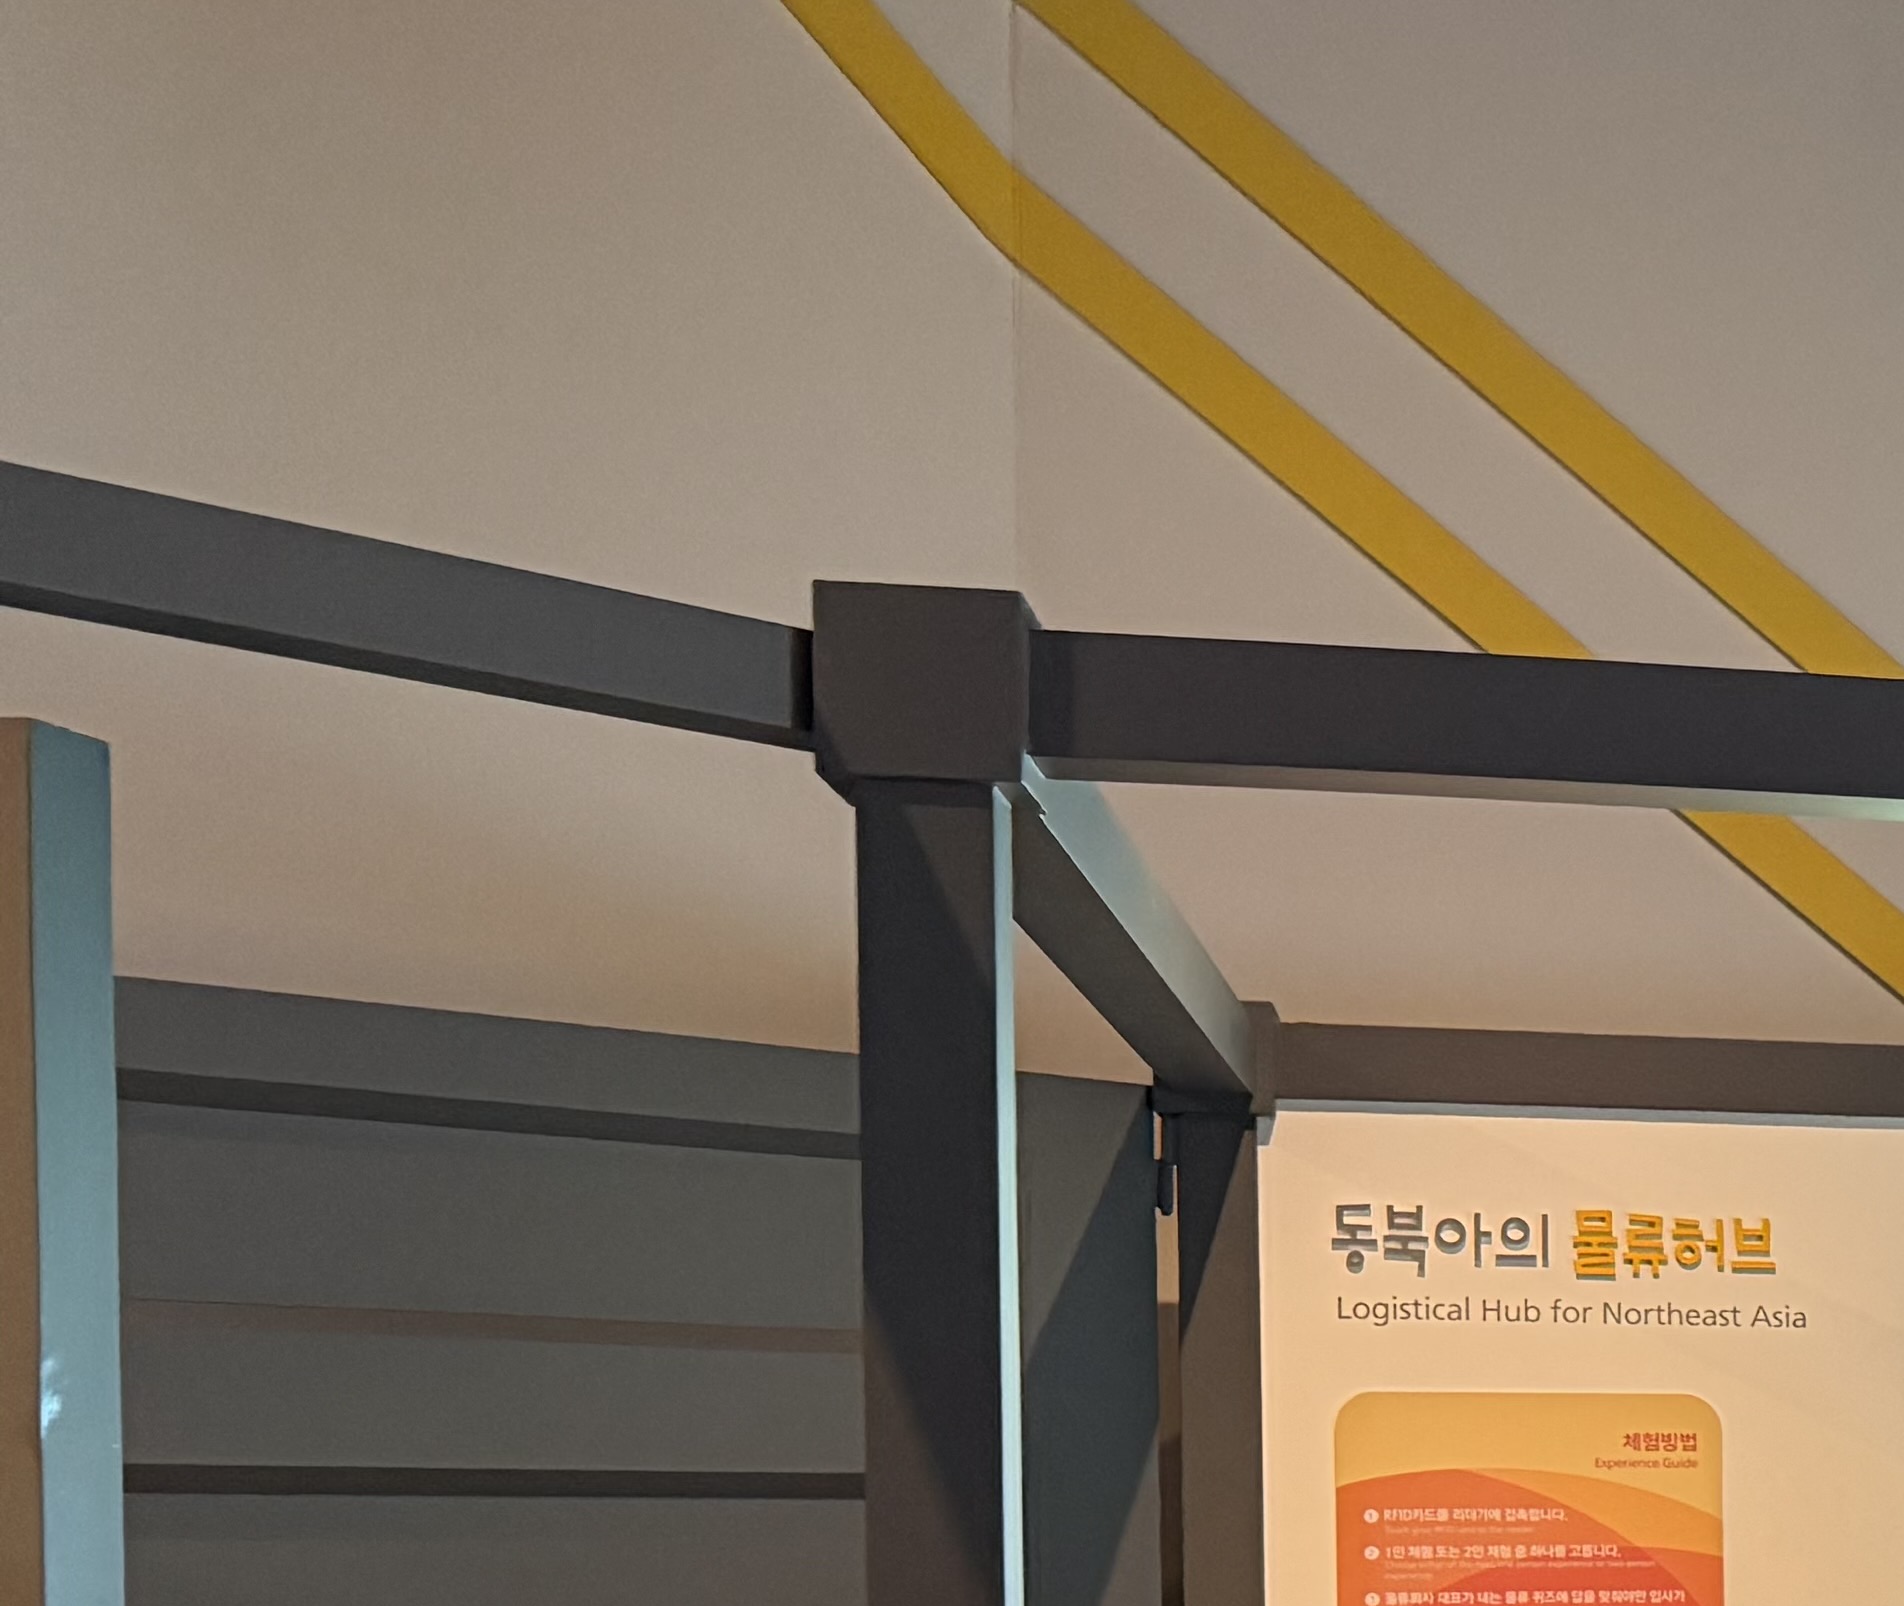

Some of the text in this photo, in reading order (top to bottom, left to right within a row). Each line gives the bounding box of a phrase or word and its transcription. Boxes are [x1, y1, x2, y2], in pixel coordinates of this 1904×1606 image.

[1331, 1203, 1777, 1282] 동북아의 물류허브
[1336, 1296, 1808, 1329] Logistical Hub for Northeast Asia
[1622, 1431, 1697, 1452] 체험방법
[1594, 1456, 1698, 1470] Experience Guide
